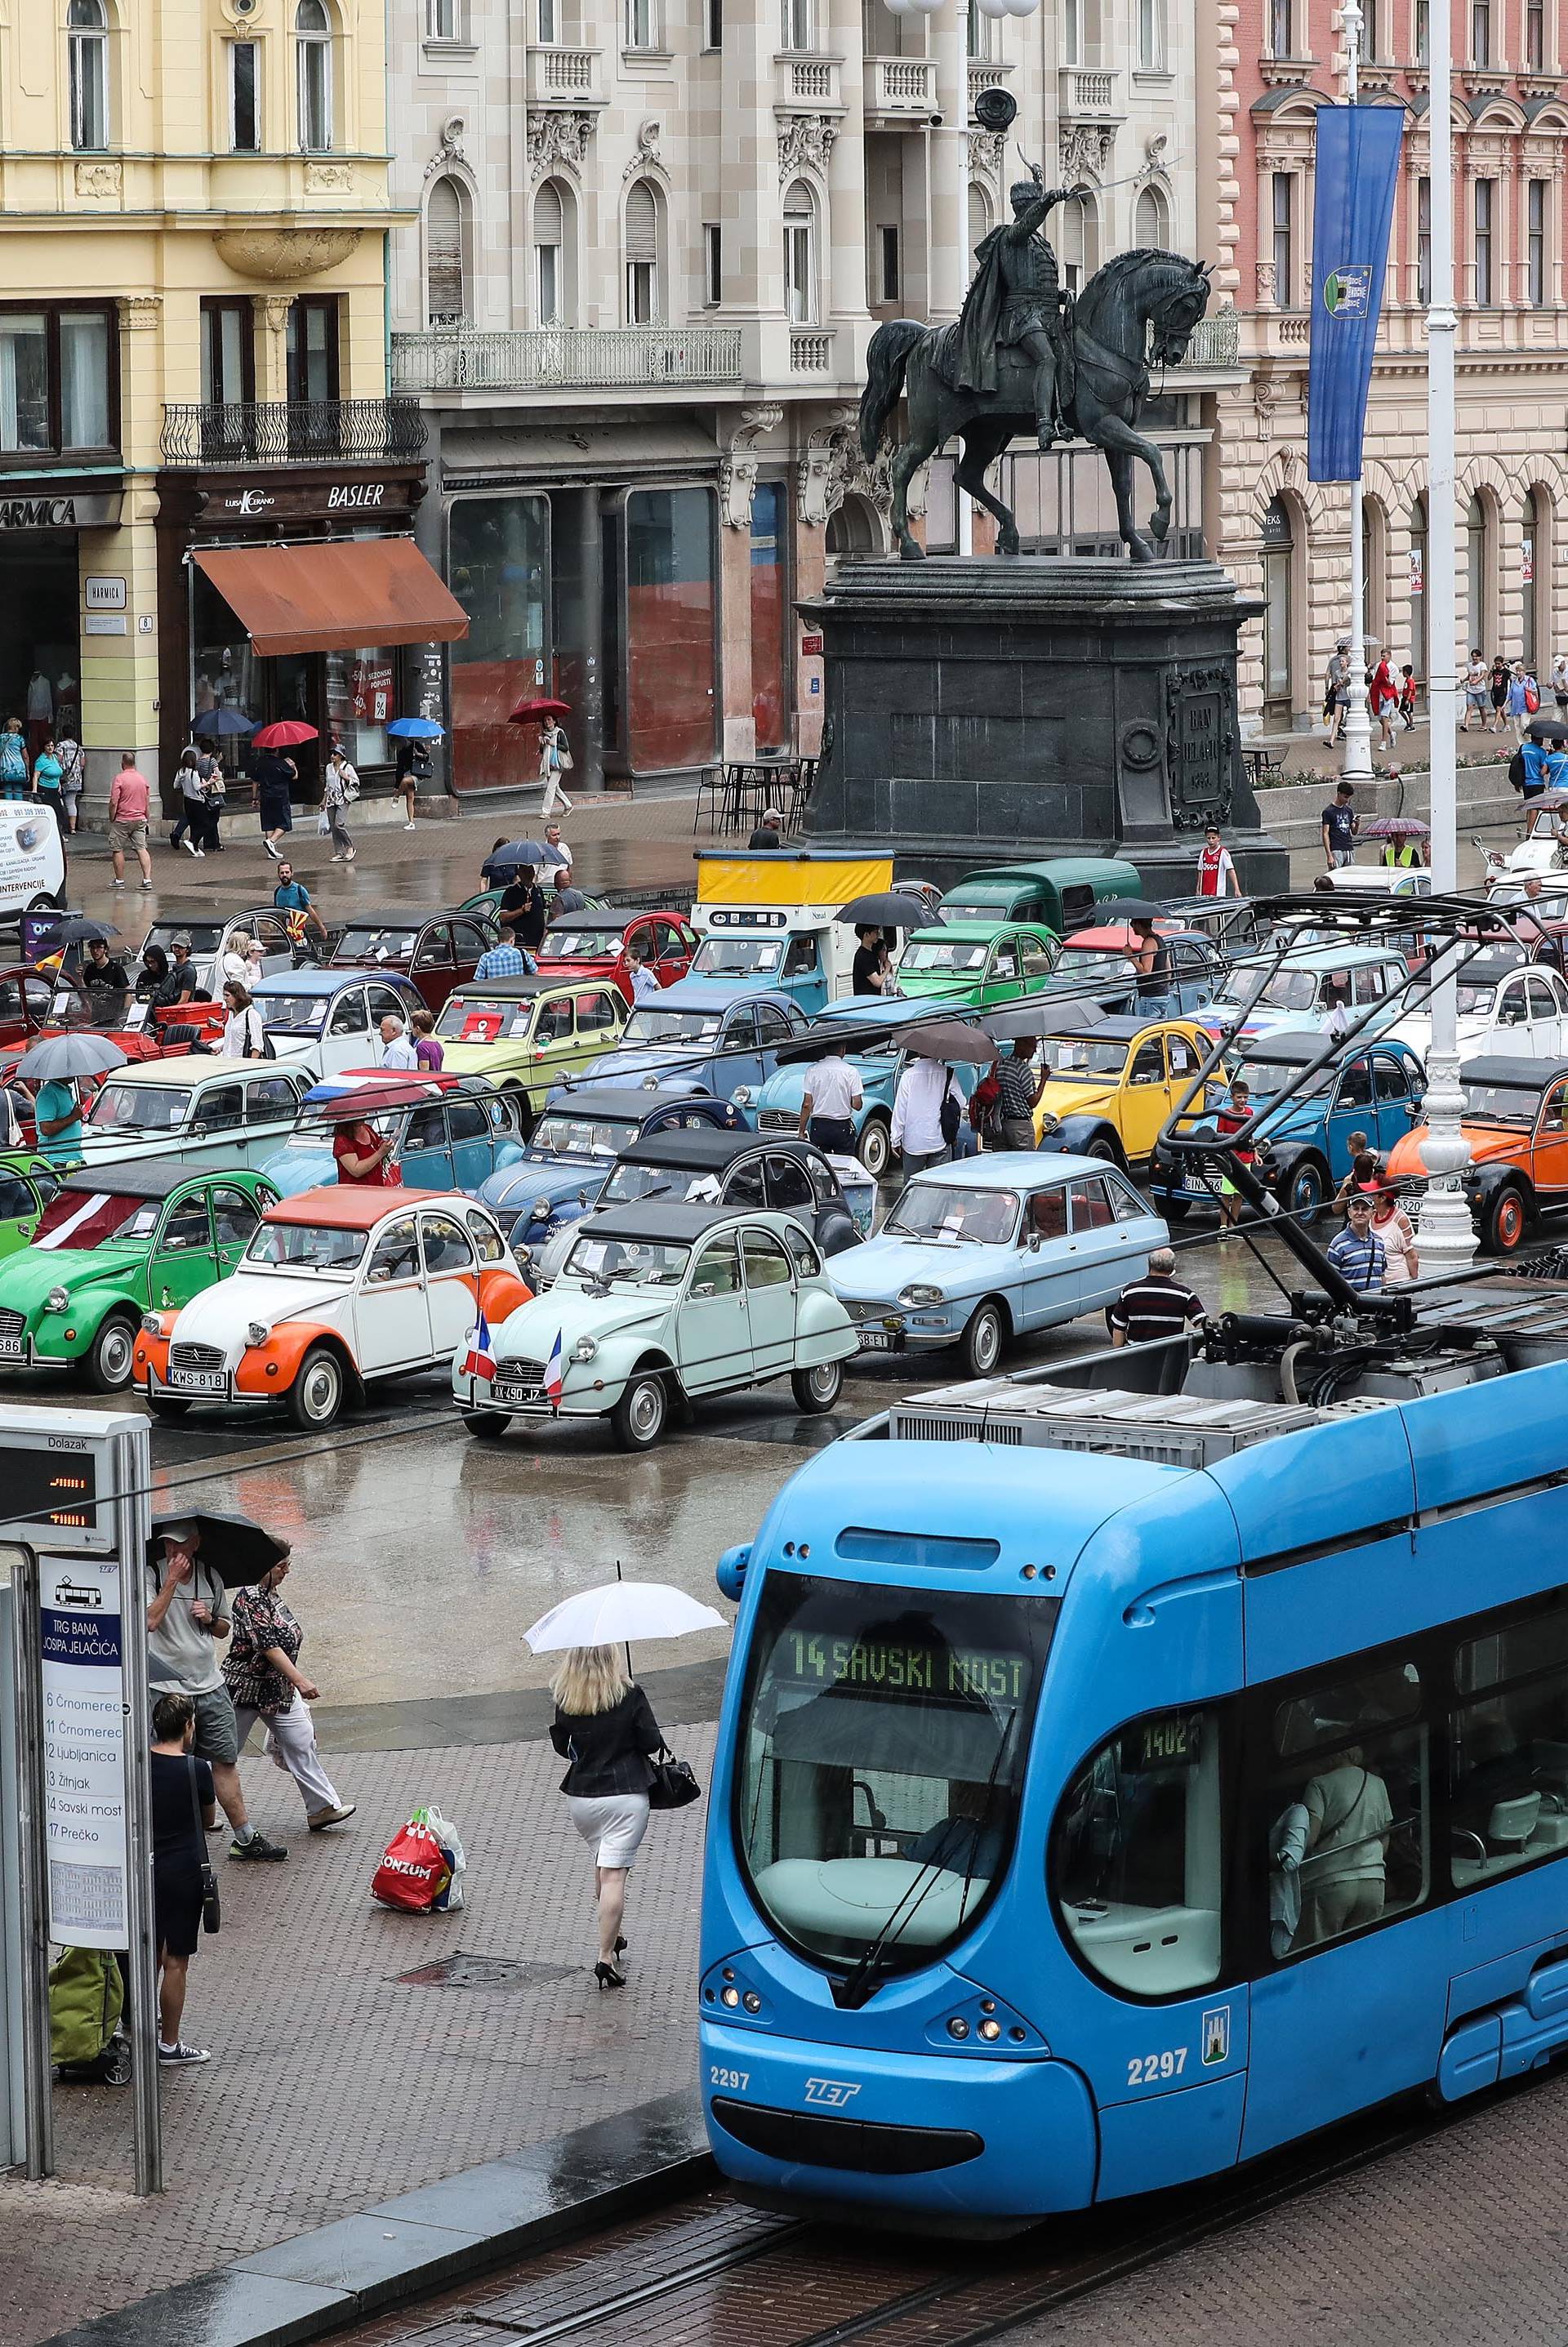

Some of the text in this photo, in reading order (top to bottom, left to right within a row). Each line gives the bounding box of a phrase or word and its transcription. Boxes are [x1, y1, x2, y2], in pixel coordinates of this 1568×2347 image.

[327, 484, 384, 508] BASLER
[92, 587, 119, 599] HARMICA
[144, 617, 148, 627] 6
[368, 668, 392, 680] SEZONSKI
[371, 678, 391, 689] POPUSTI
[172, 1368, 223, 1387] KWS-818
[48, 1437, 87, 1450] Dolazak
[53, 1619, 99, 1636] TRG BANA
[43, 1637, 118, 1655] JOSIPA JELAČIĆA
[790, 1632, 1024, 1698] 14 SAVSKI MOST
[47, 1692, 120, 1712] 6 Črnomerec
[46, 1719, 122, 1738] 11 Črnomerec
[45, 1742, 116, 1762] 12 Ljubljanica
[46, 1770, 91, 1790] 13 Žitnjak
[47, 1795, 122, 1816] 14 Savski most
[49, 1823, 99, 1841] 17 Prečko
[1128, 2047, 1187, 2086] 2297
[710, 2065, 750, 2091] 2297
[804, 2078, 862, 2107] ZET
